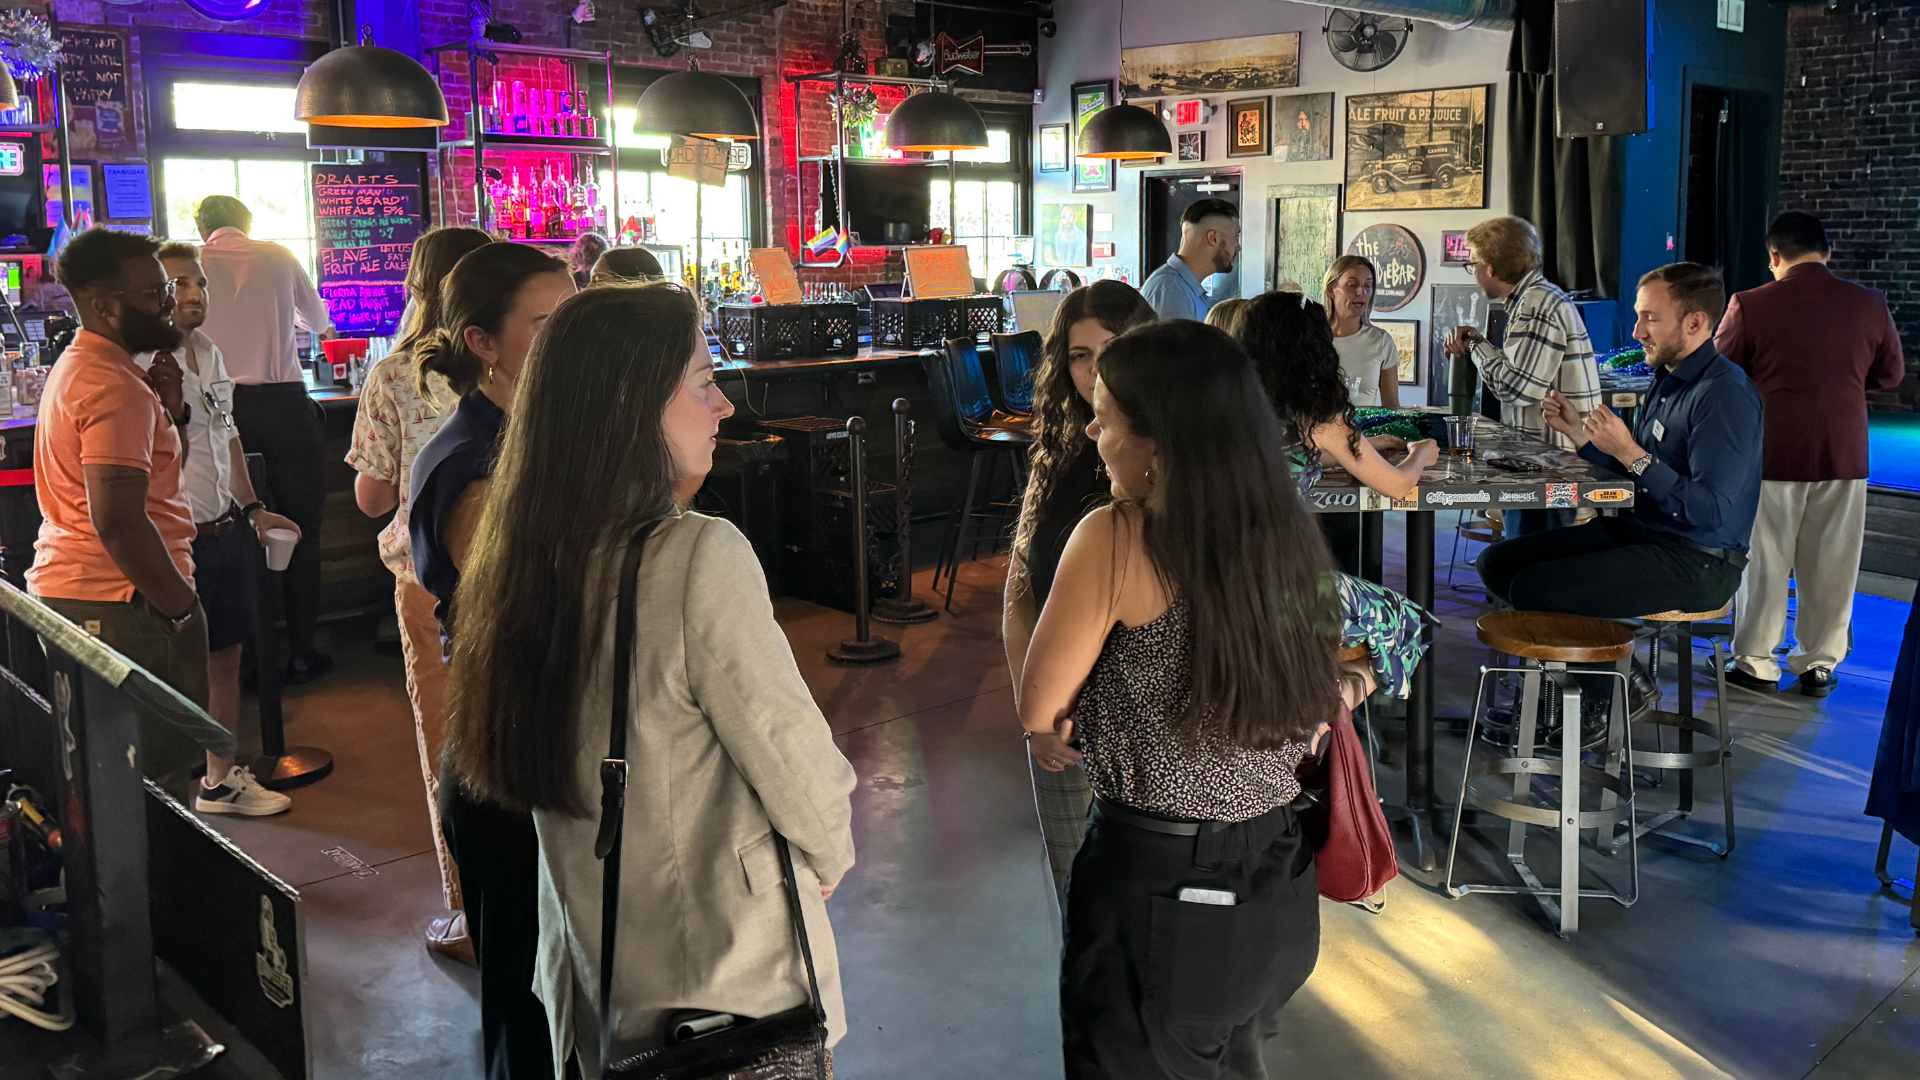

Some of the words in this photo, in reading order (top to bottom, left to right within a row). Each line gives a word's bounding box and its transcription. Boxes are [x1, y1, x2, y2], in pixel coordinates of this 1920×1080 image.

[94, 37, 117, 49] NOT
[944, 49, 980, 60] Budweiser
[96, 71, 122, 84] NOT
[1177, 100, 1201, 125] EXIT
[1374, 108, 1406, 121] FRUIT
[1408, 108, 1417, 121] &
[667, 147, 709, 162] ORDR
[315, 174, 399, 185] DRAFTS
[318, 188, 354, 197] GREEN
[357, 189, 382, 197] MAN
[319, 207, 353, 216] WHITE
[353, 207, 375, 216] ALE
[1356, 232, 1379, 256] the
[343, 249, 371, 262] AVE.
[388, 253, 403, 261] EAT
[324, 263, 355, 276] FRUIT
[360, 260, 381, 273] ALE
[322, 287, 357, 298] FLORIDA
